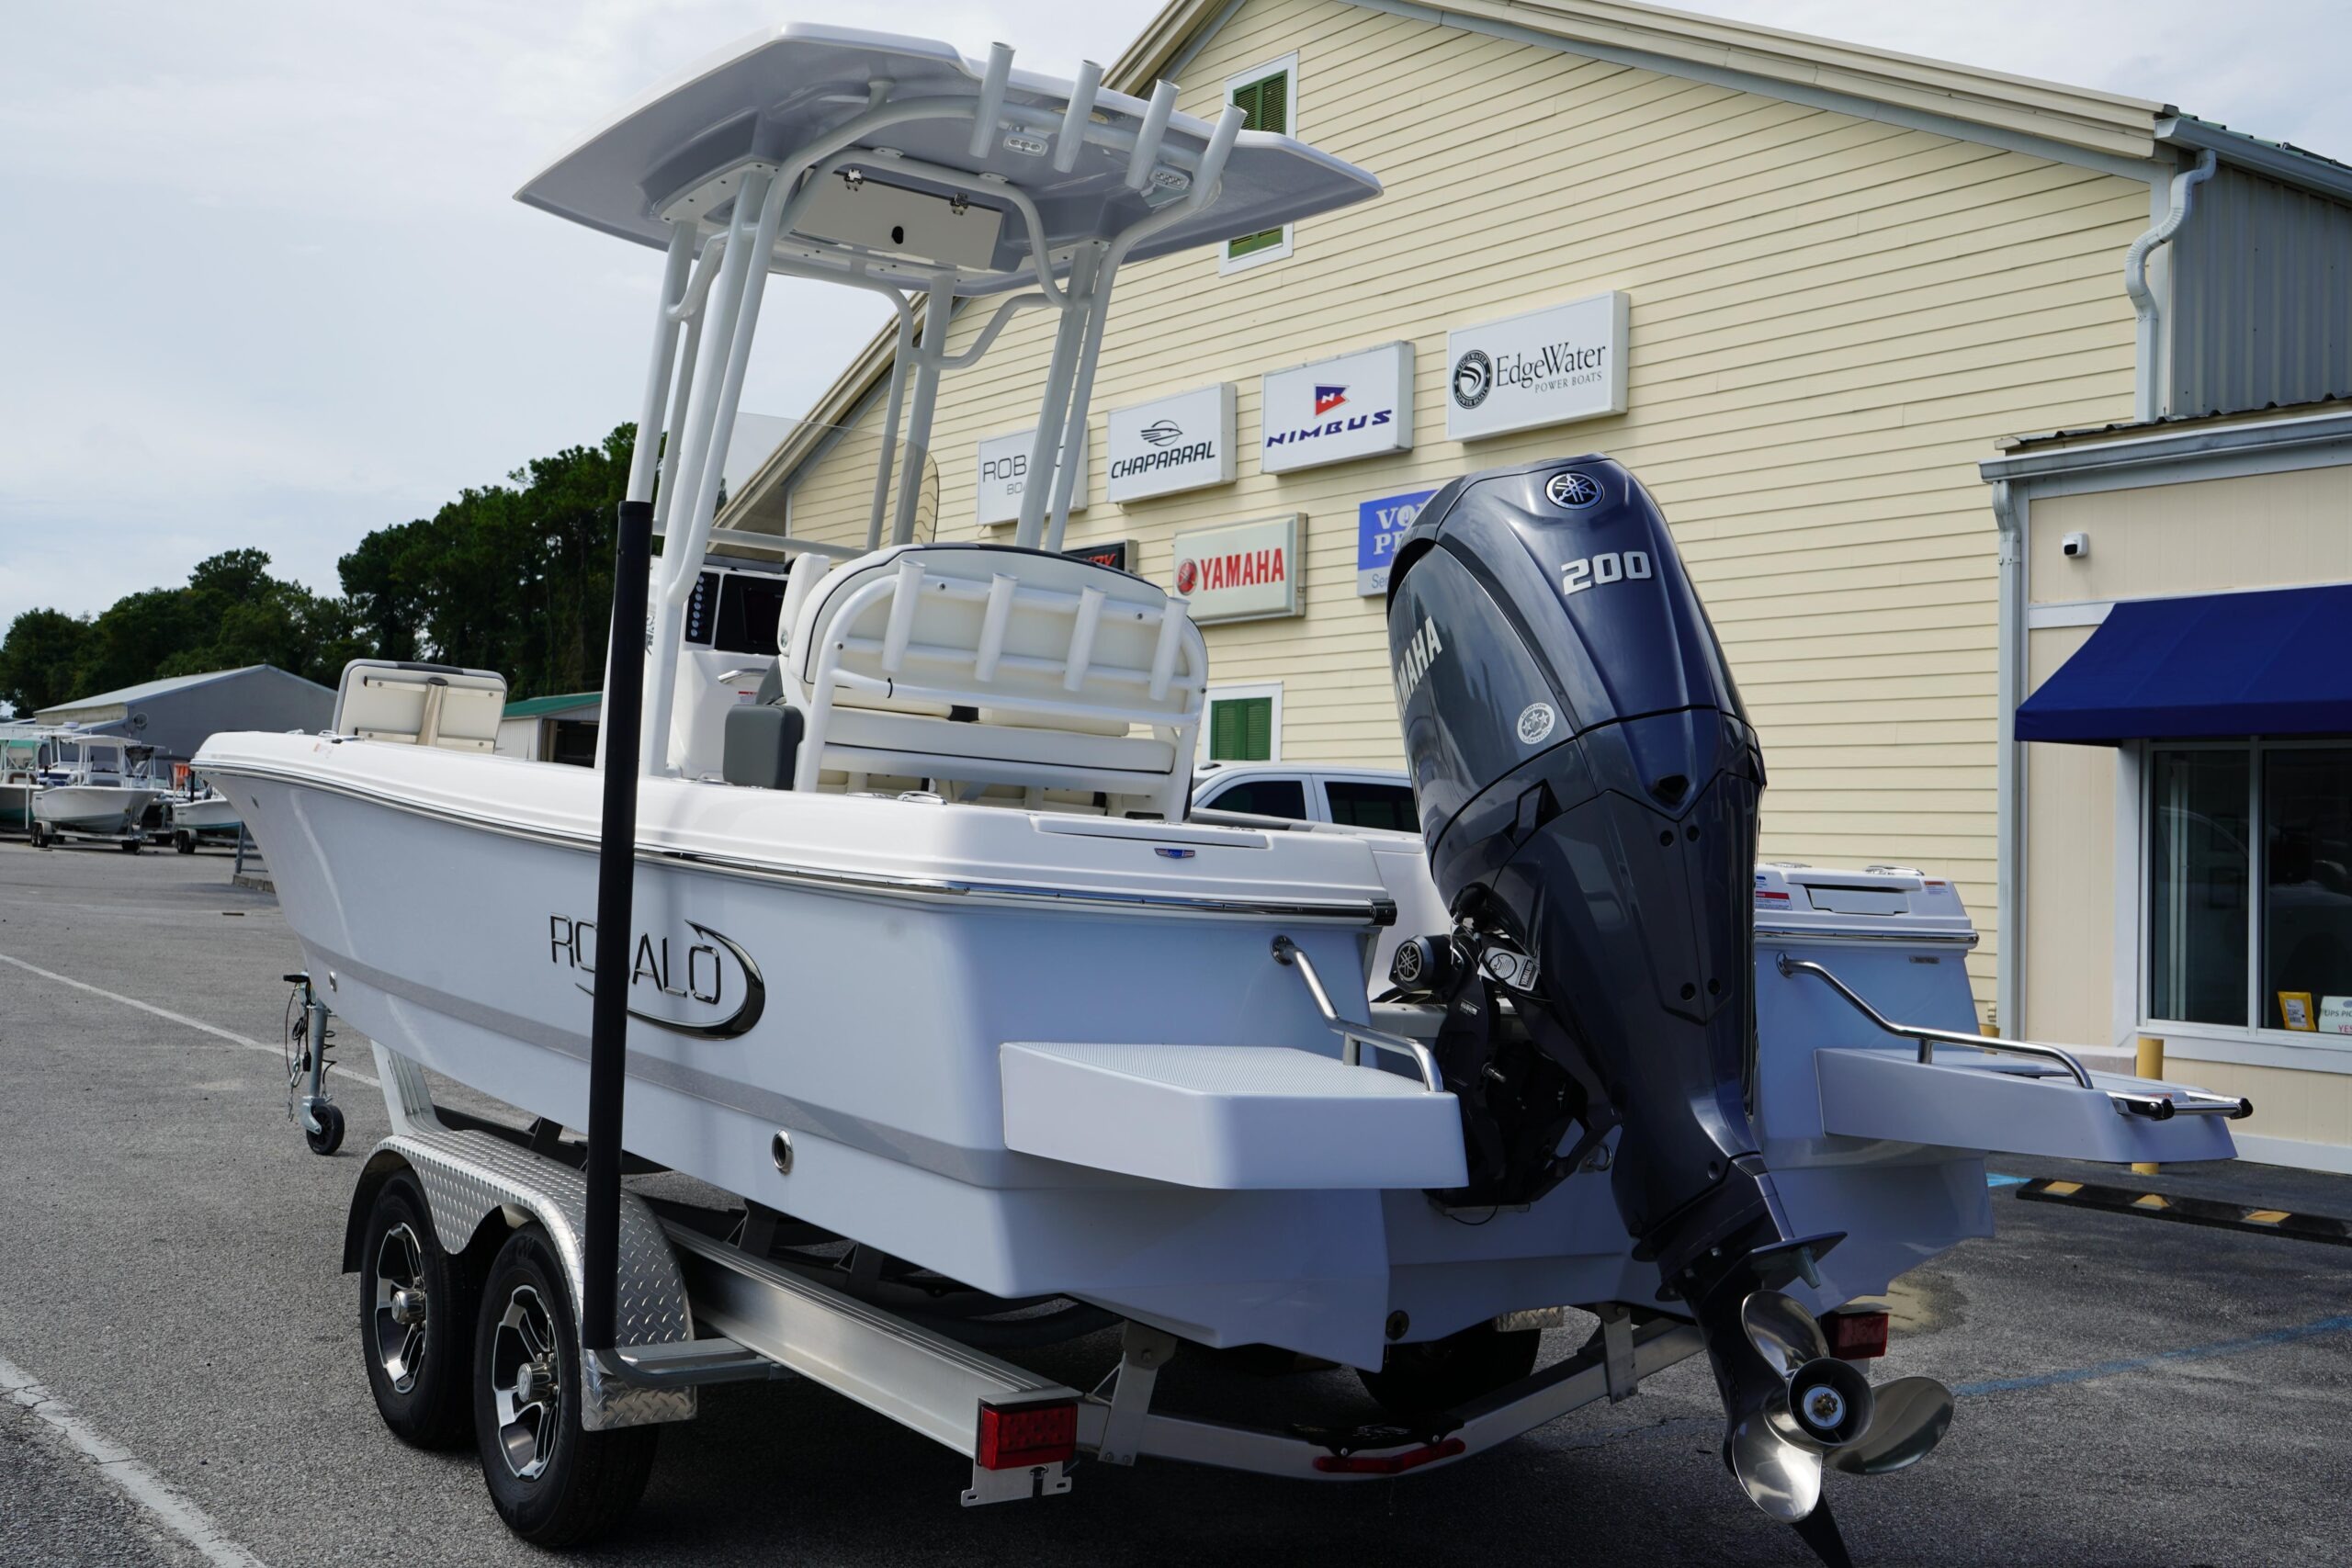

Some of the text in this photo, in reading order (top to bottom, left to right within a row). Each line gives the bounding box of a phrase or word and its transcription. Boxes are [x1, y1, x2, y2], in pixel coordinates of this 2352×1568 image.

[1496, 342, 1606, 389] EdgeWater
[1534, 371, 1602, 393] POWER BOATS
[1266, 409, 1392, 448] NIMBUS
[1111, 441, 1216, 479] CHAPARRAL
[1201, 548, 1284, 592] YAMAHA
[1561, 551, 1651, 595] 200
[1396, 615, 1442, 719] MAHA
[550, 912, 721, 1005] ROALO
